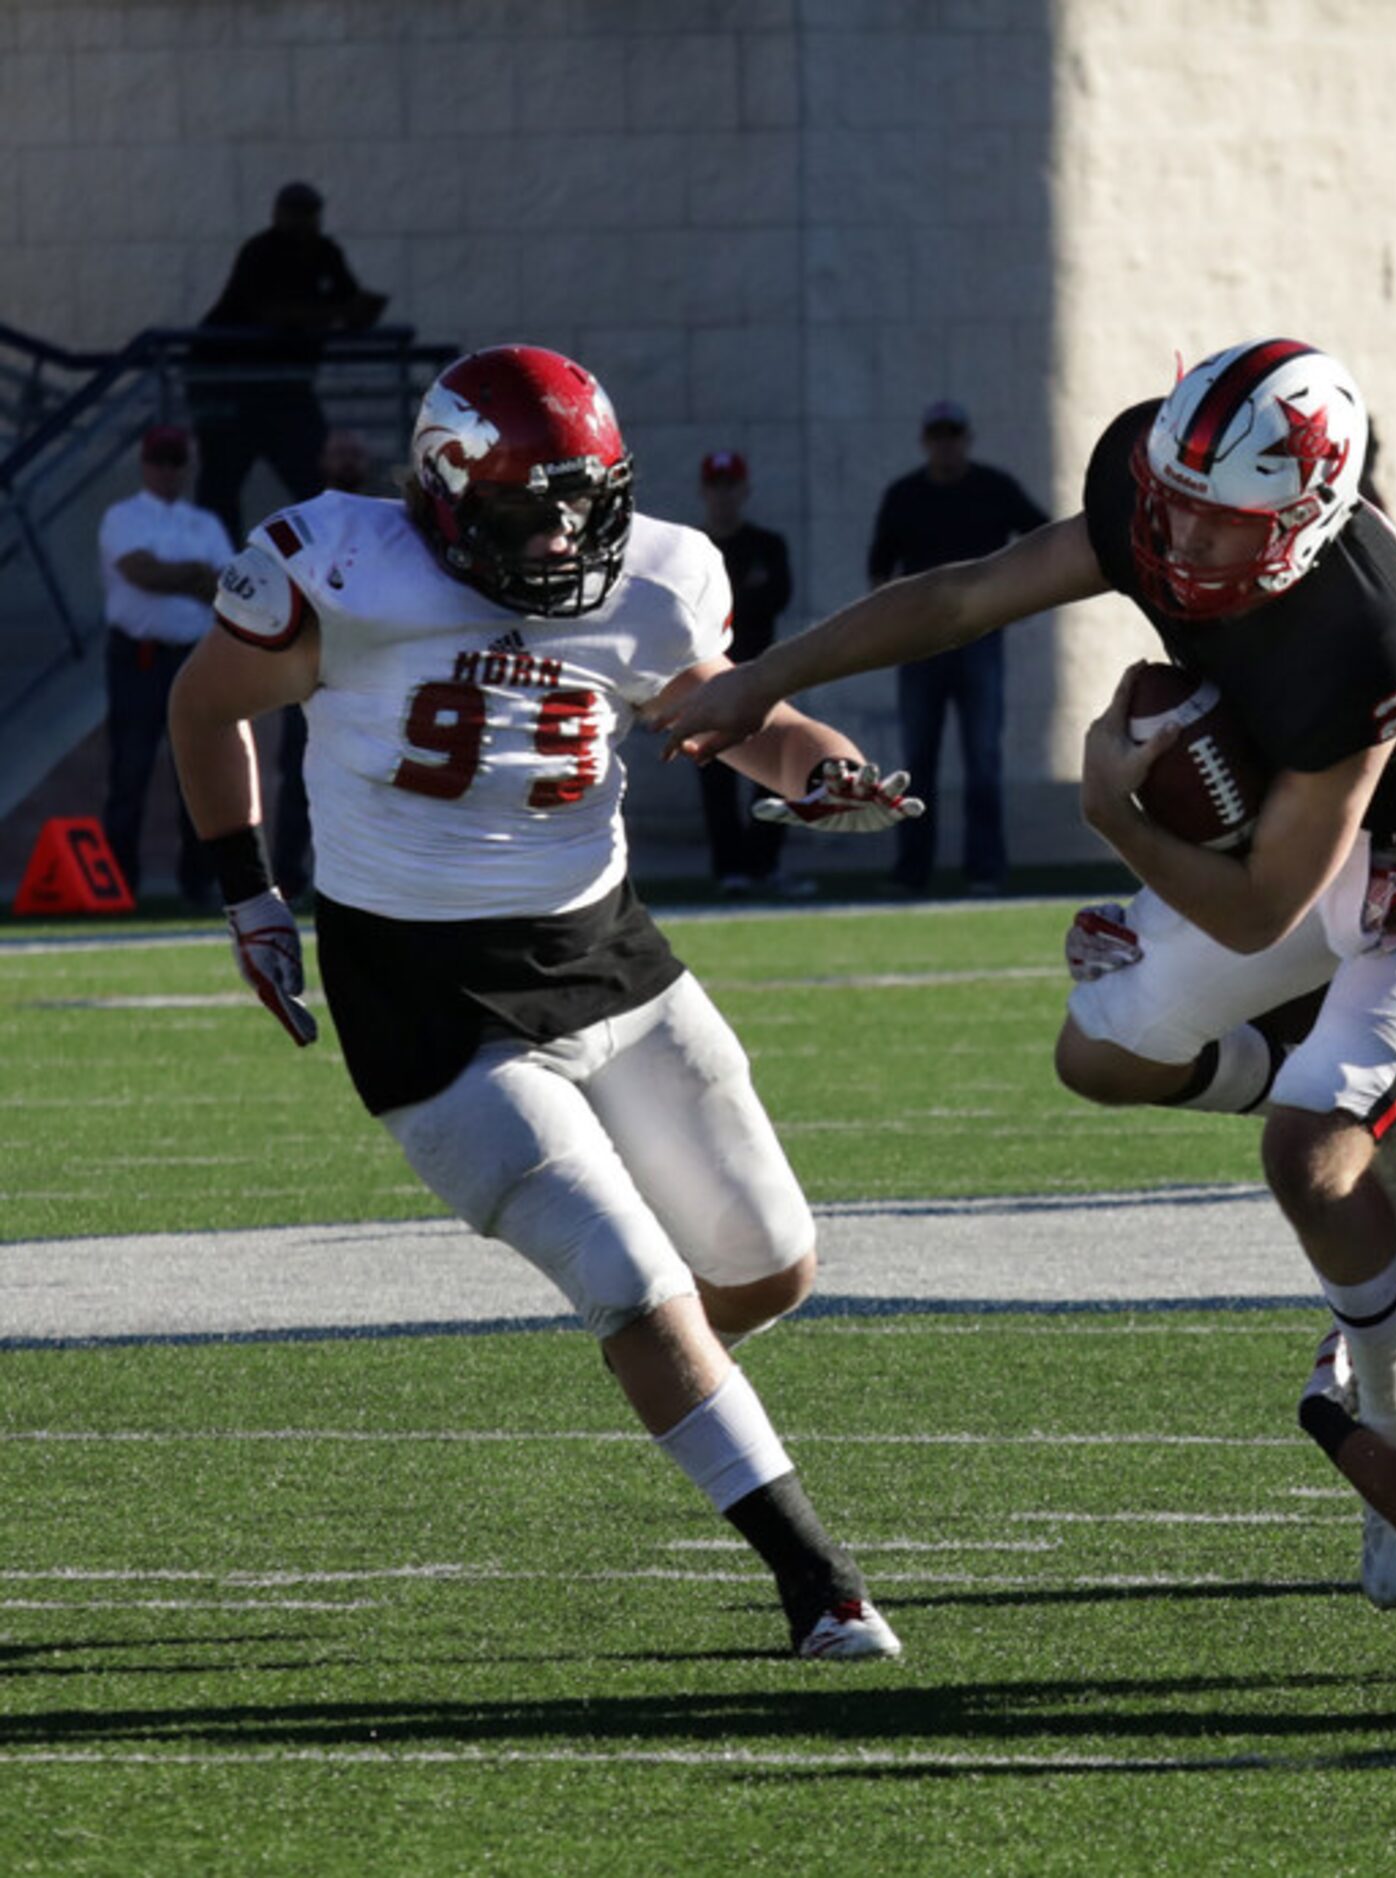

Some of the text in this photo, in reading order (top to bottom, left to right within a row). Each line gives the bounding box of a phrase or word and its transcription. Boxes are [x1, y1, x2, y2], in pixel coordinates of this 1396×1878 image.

[1164, 463, 1208, 493] Riddell
[453, 651, 563, 686] HORN
[66, 828, 122, 898] G
